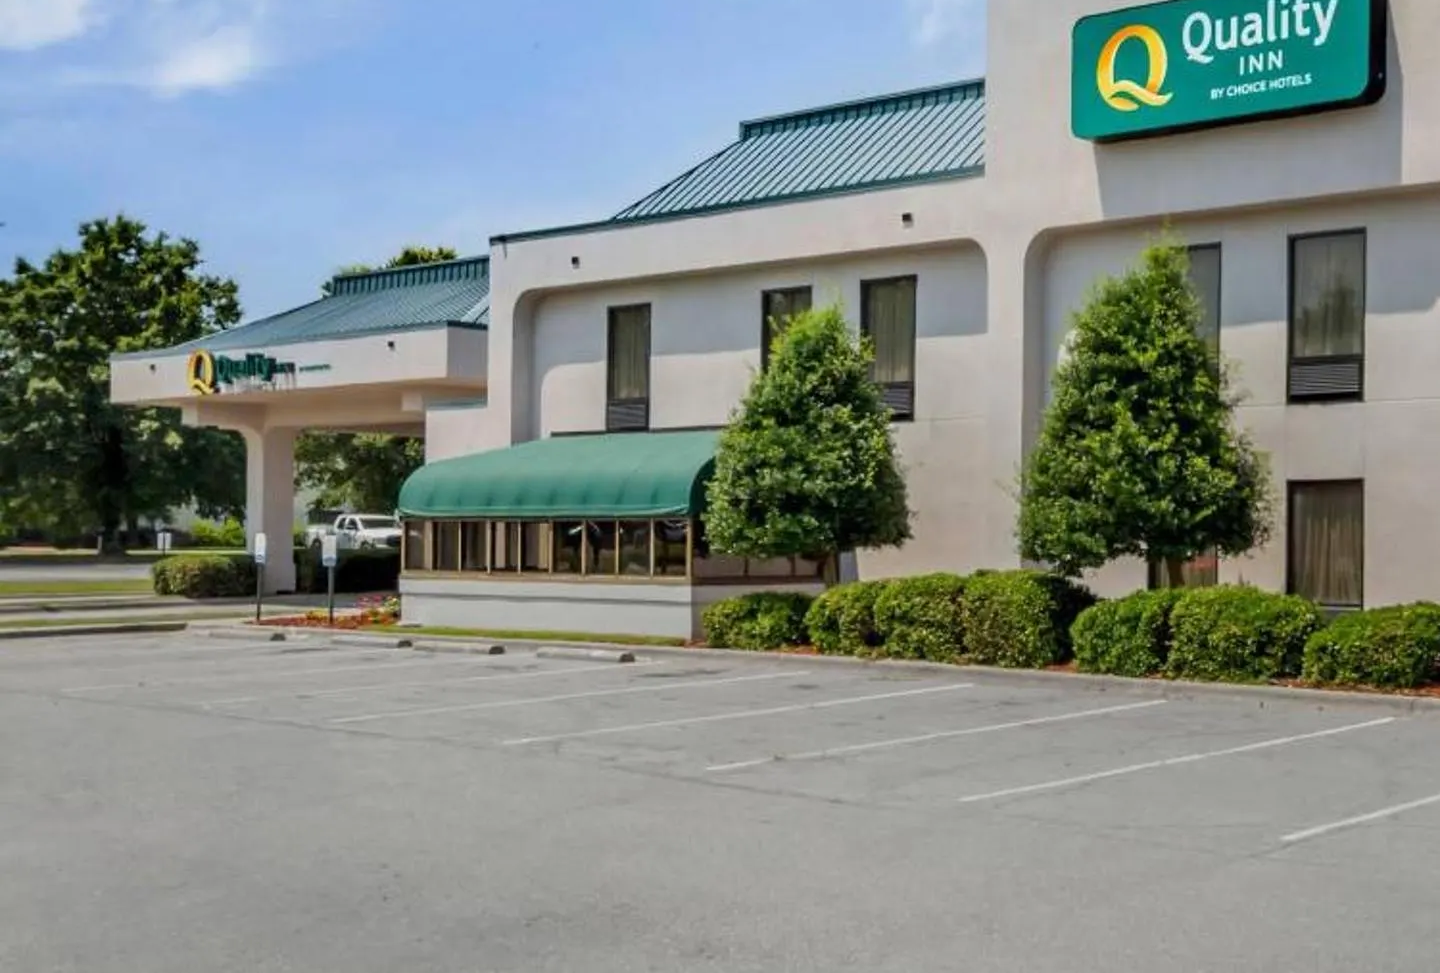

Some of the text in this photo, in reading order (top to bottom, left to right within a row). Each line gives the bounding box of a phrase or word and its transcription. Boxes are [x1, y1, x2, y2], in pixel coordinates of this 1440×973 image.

[1096, 24, 1173, 111] Q
[1239, 49, 1283, 76] INN
[1210, 72, 1313, 100] BY CHOICE HOTELS
[187, 349, 218, 394] Q
